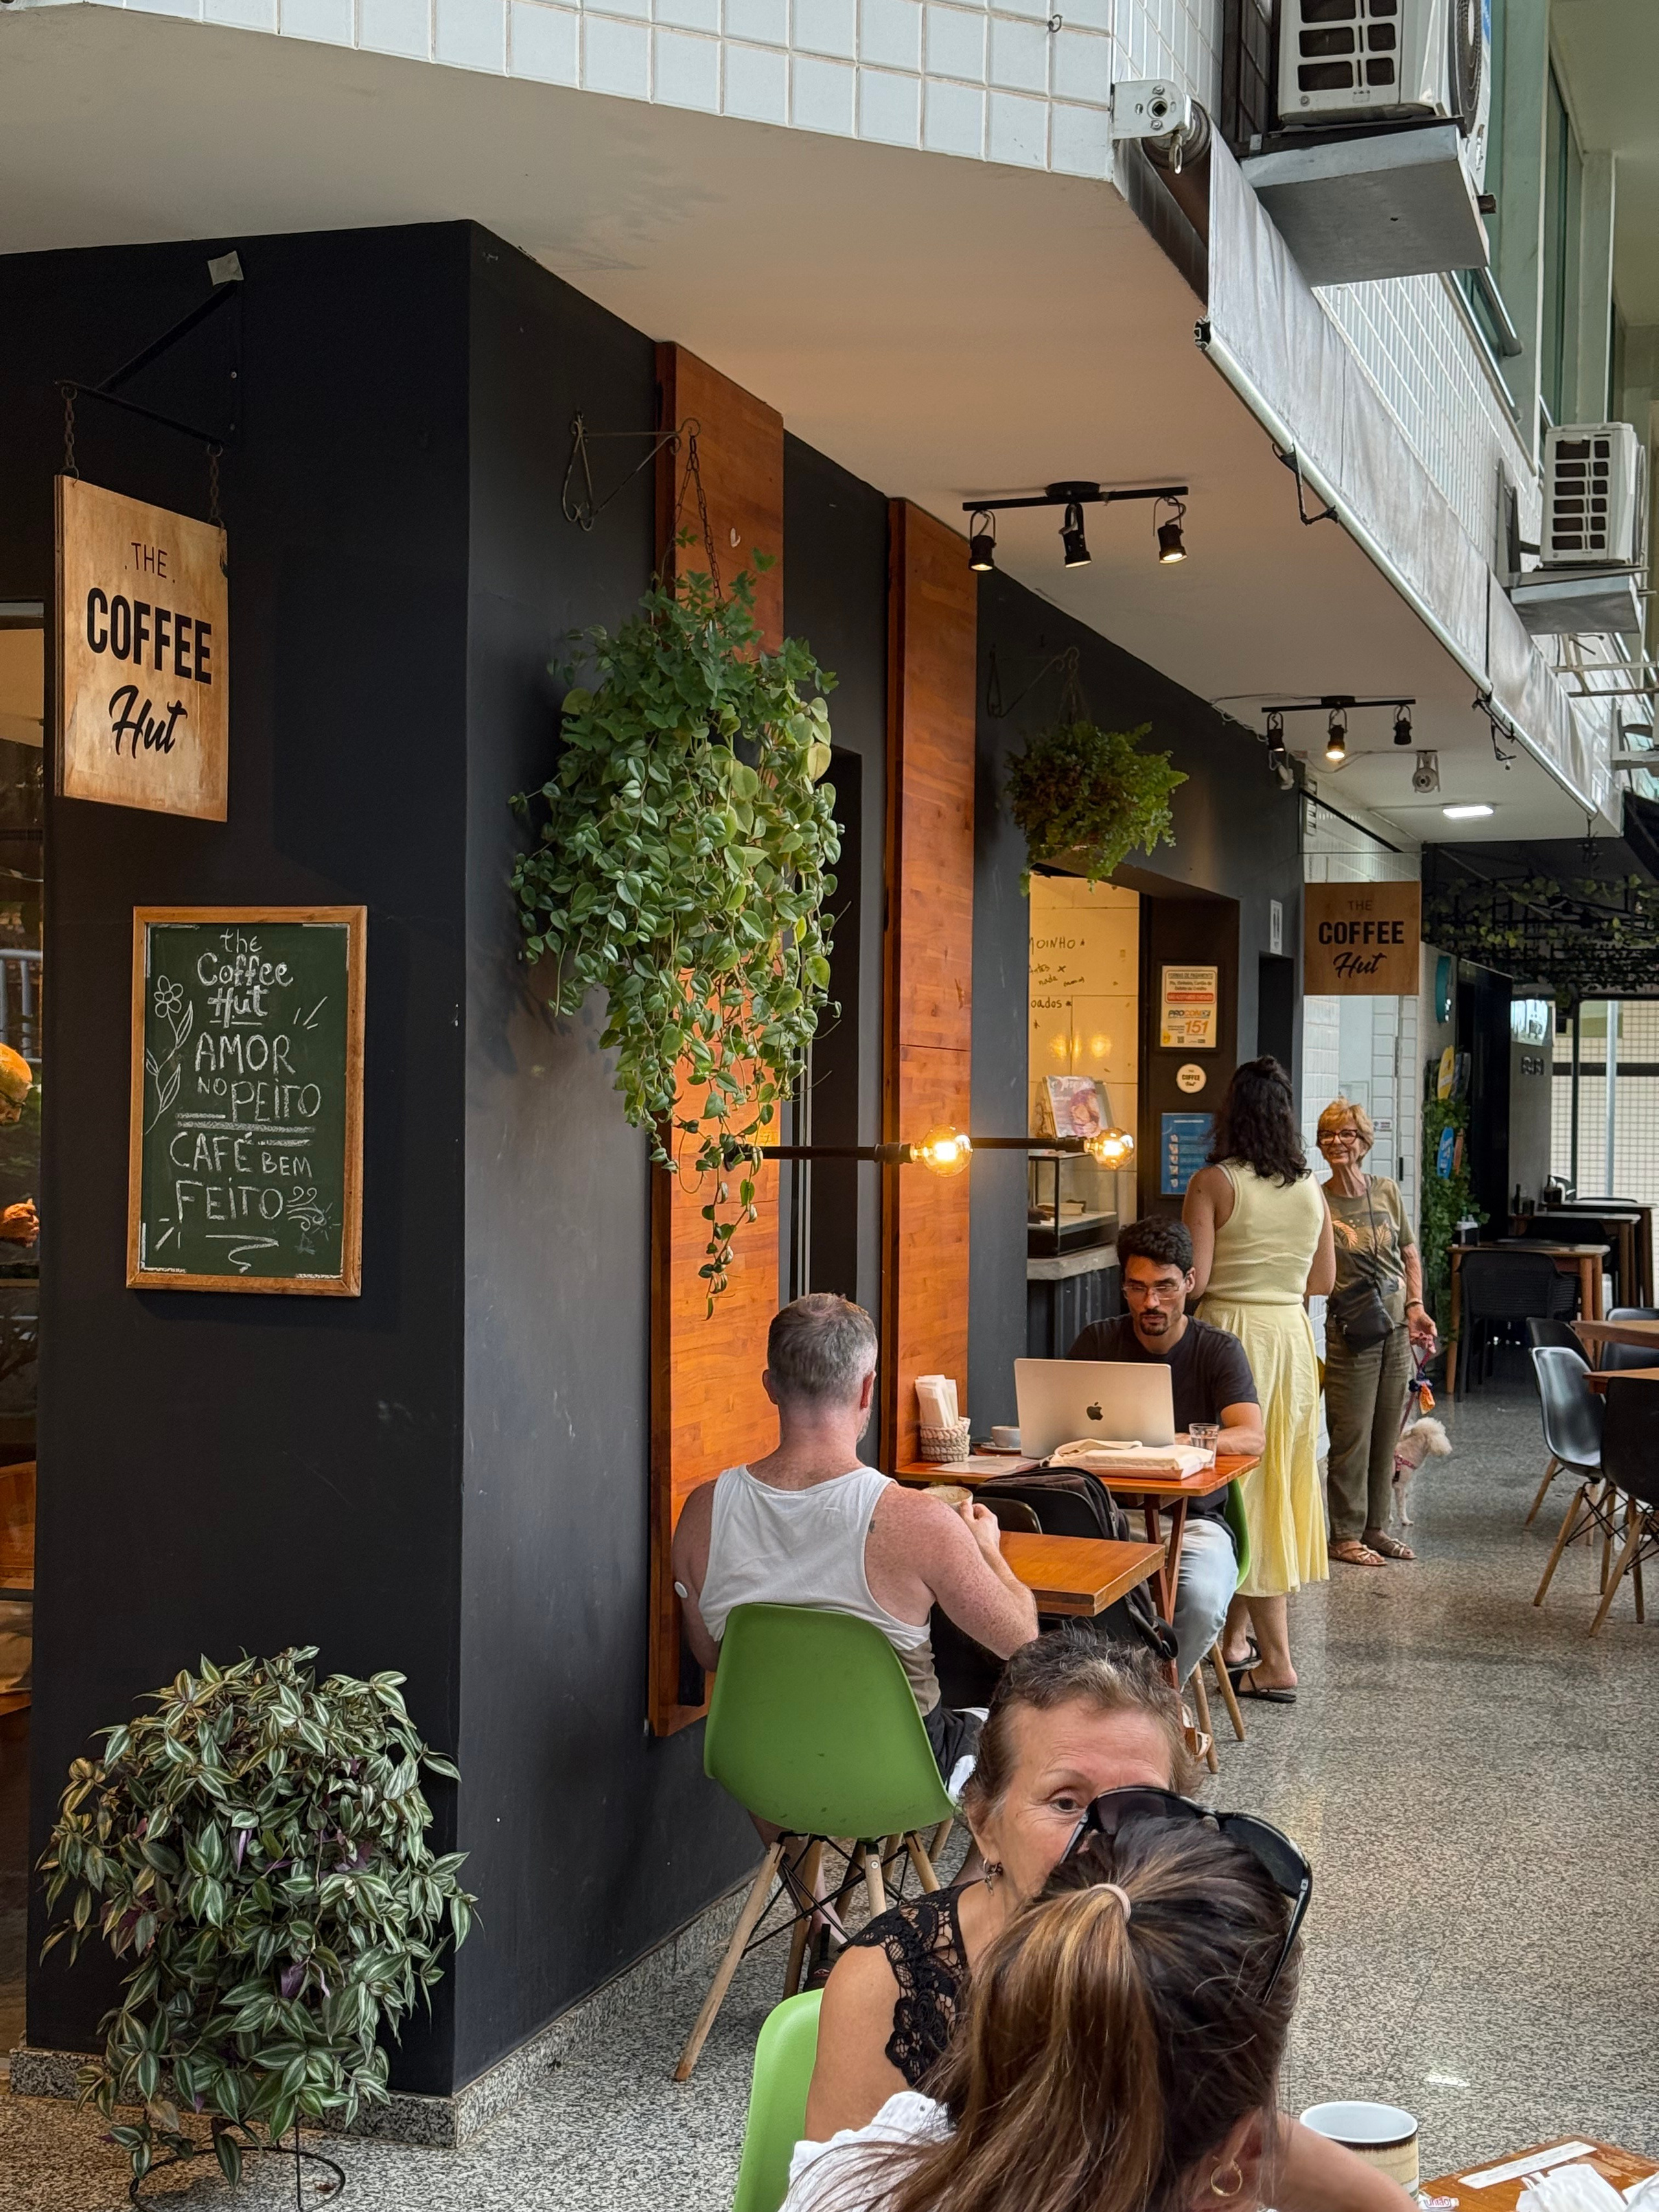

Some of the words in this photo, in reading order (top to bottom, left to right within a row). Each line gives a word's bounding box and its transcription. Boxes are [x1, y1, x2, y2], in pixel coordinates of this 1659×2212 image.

[131, 542, 168, 579] THE
[86, 587, 212, 685] COFFEE
[108, 684, 188, 759] Hut
[1347, 900, 1373, 911] THE
[220, 928, 262, 953] the
[1318, 920, 1404, 945] COFFEE
[196, 952, 294, 988] Coffee
[1332, 951, 1387, 979] Hut
[207, 986, 269, 1028] Hut
[1185, 1020, 1209, 1034] 151
[195, 1031, 296, 1075] AMOR
[197, 1076, 227, 1097] NO
[231, 1079, 322, 1123] PEITO
[169, 1131, 253, 1172] CAFÉ
[261, 1151, 314, 1178] BEM
[174, 1177, 284, 1222] FEITO
